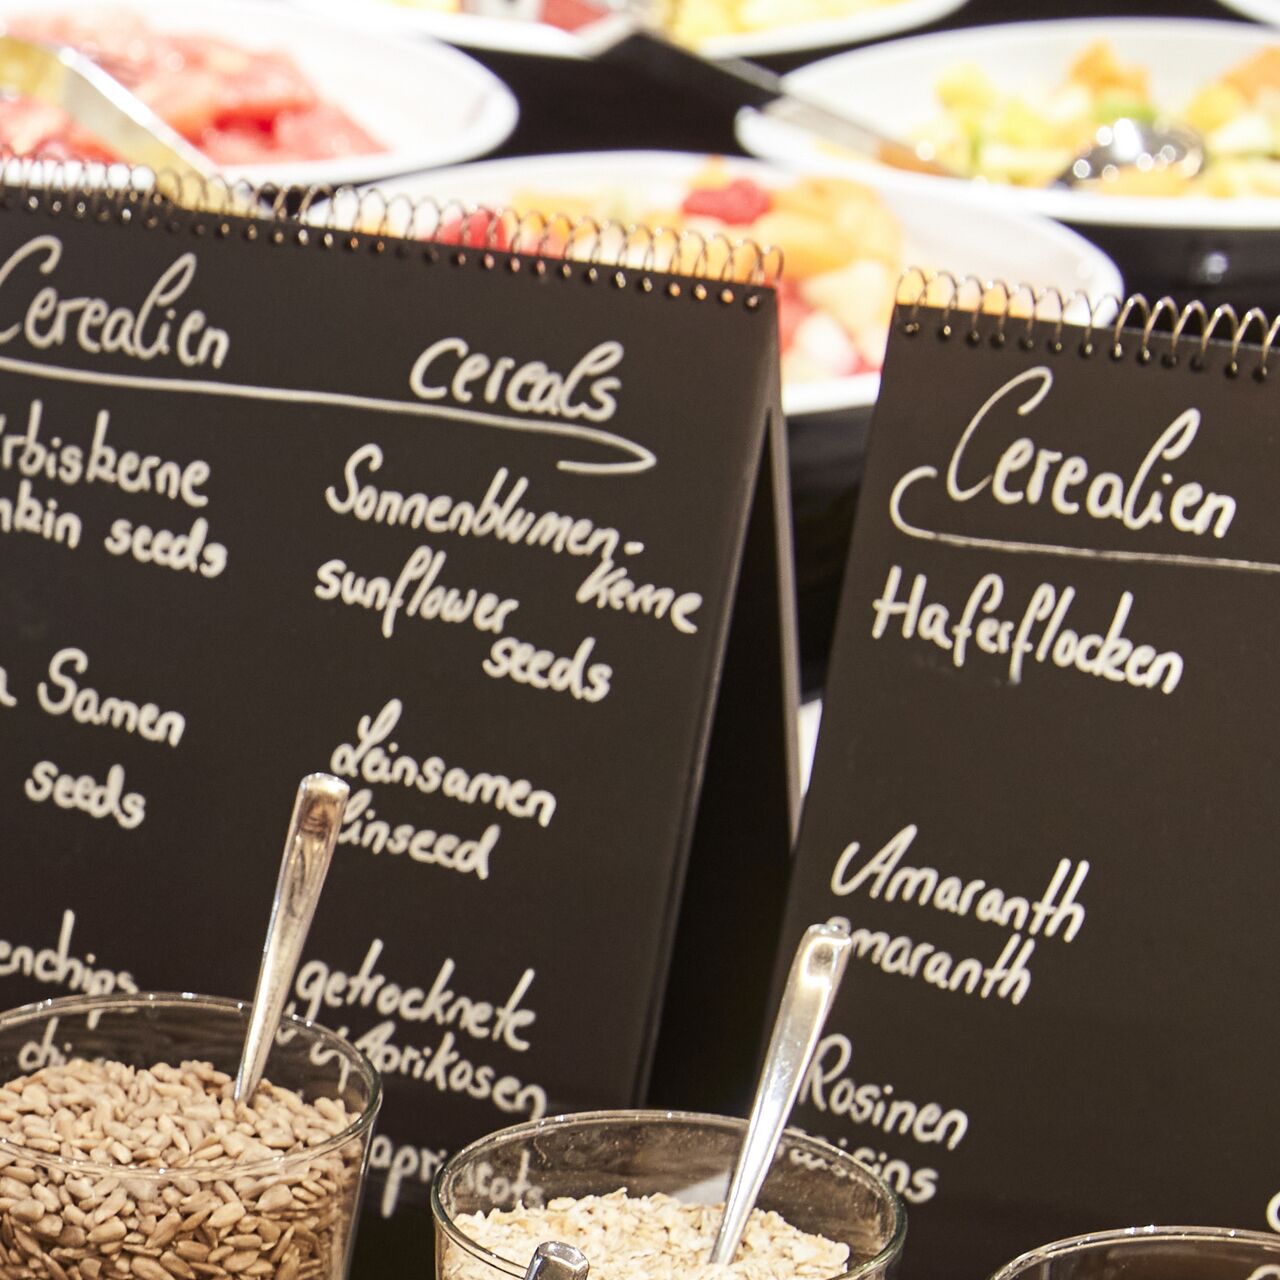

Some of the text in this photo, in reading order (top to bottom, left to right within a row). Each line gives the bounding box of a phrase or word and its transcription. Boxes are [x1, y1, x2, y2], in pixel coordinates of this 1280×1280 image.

[325, 442, 645, 562] Sonnenblumen-
[946, 365, 1237, 539] Cerealien
[103, 516, 229, 578] seeds
[314, 544, 520, 639] sunflower
[482, 635, 613, 703] seeds
[872, 564, 1185, 695] Haferflocken
[36, 646, 187, 748] Samen
[24, 760, 147, 830] seeds
[829, 823, 1090, 944] Amaranth
[797, 1032, 969, 1152] Rosinen
